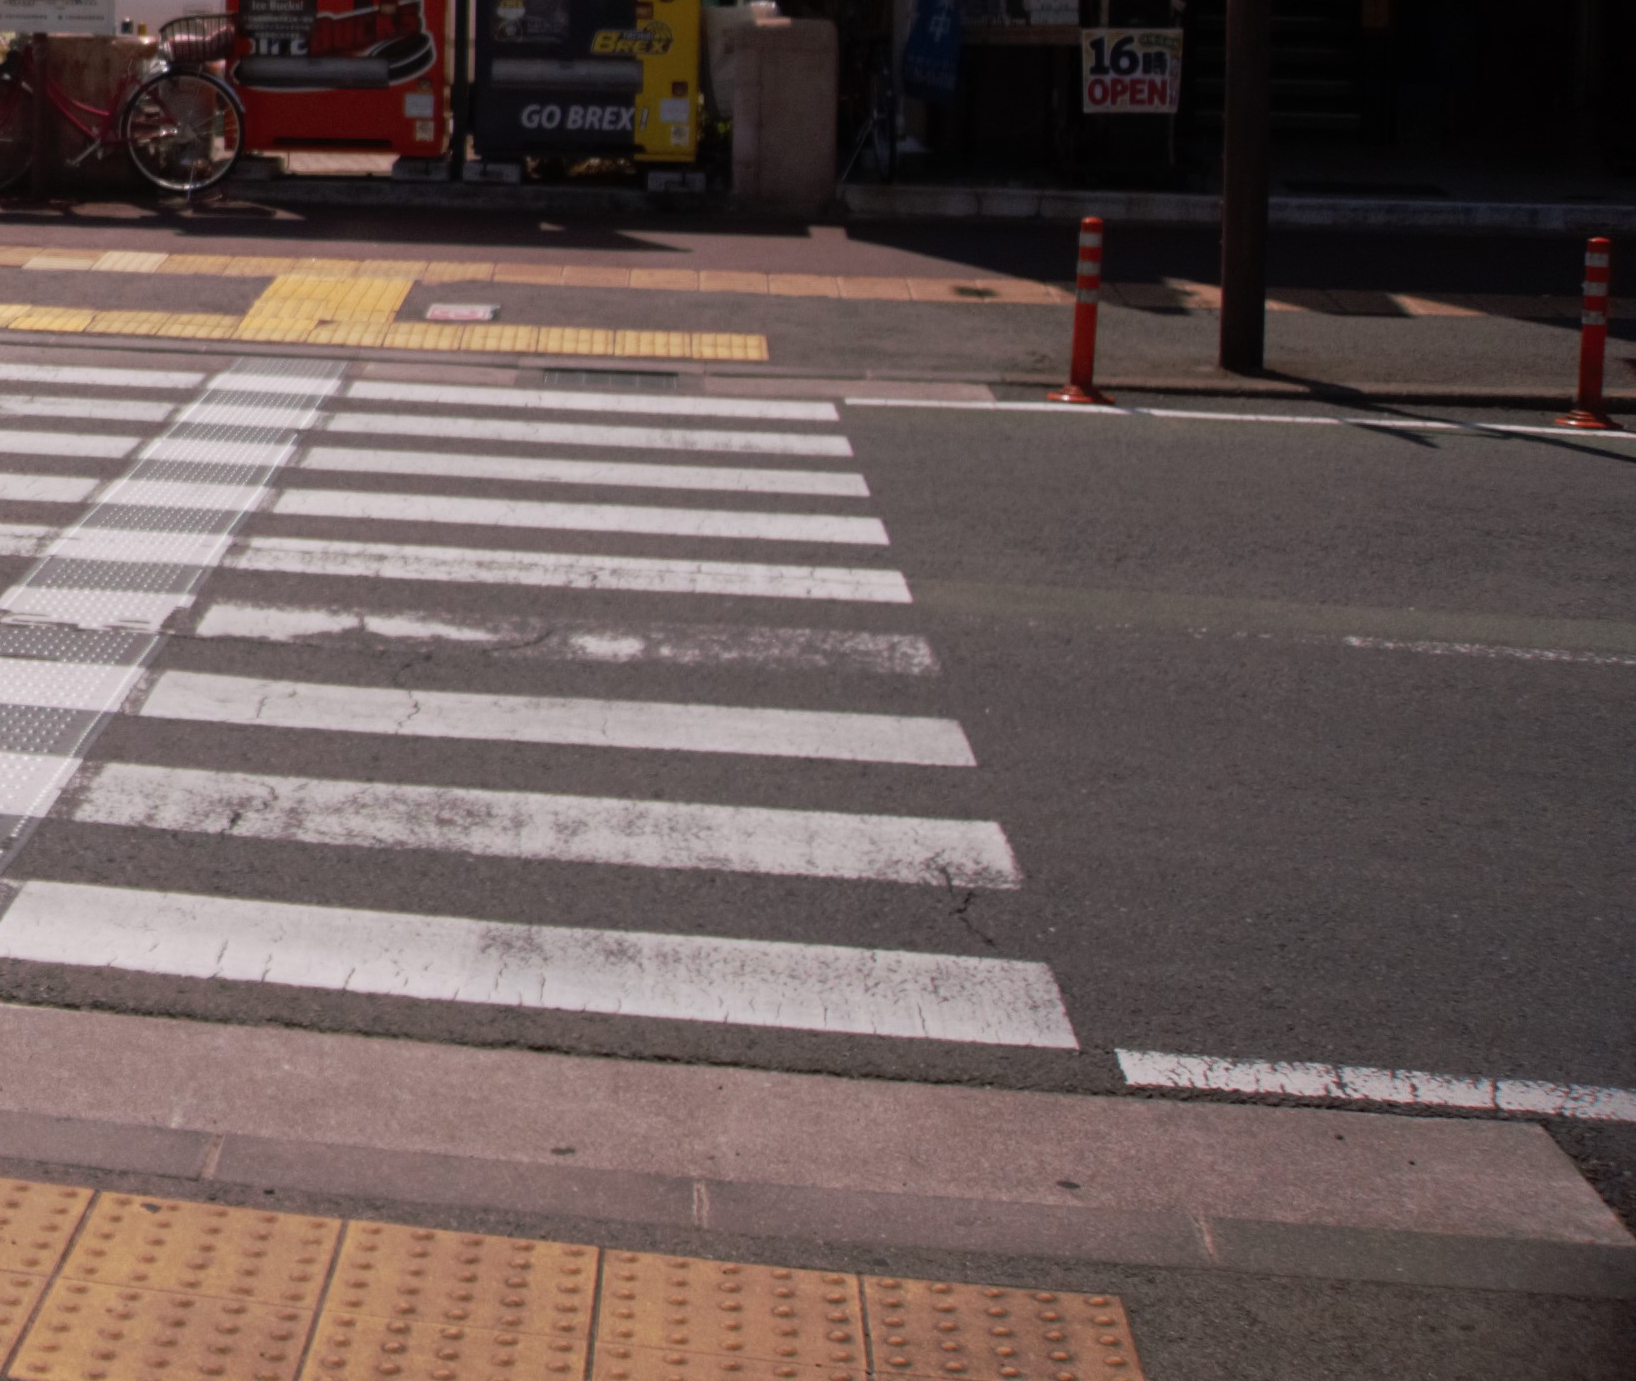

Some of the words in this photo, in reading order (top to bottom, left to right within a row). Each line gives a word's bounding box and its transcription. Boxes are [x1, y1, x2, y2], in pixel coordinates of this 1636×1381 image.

[593, 32, 670, 55] BREX
[1088, 36, 1168, 77] 16時
[1087, 79, 1168, 107] OPEN
[521, 105, 563, 130] GO
